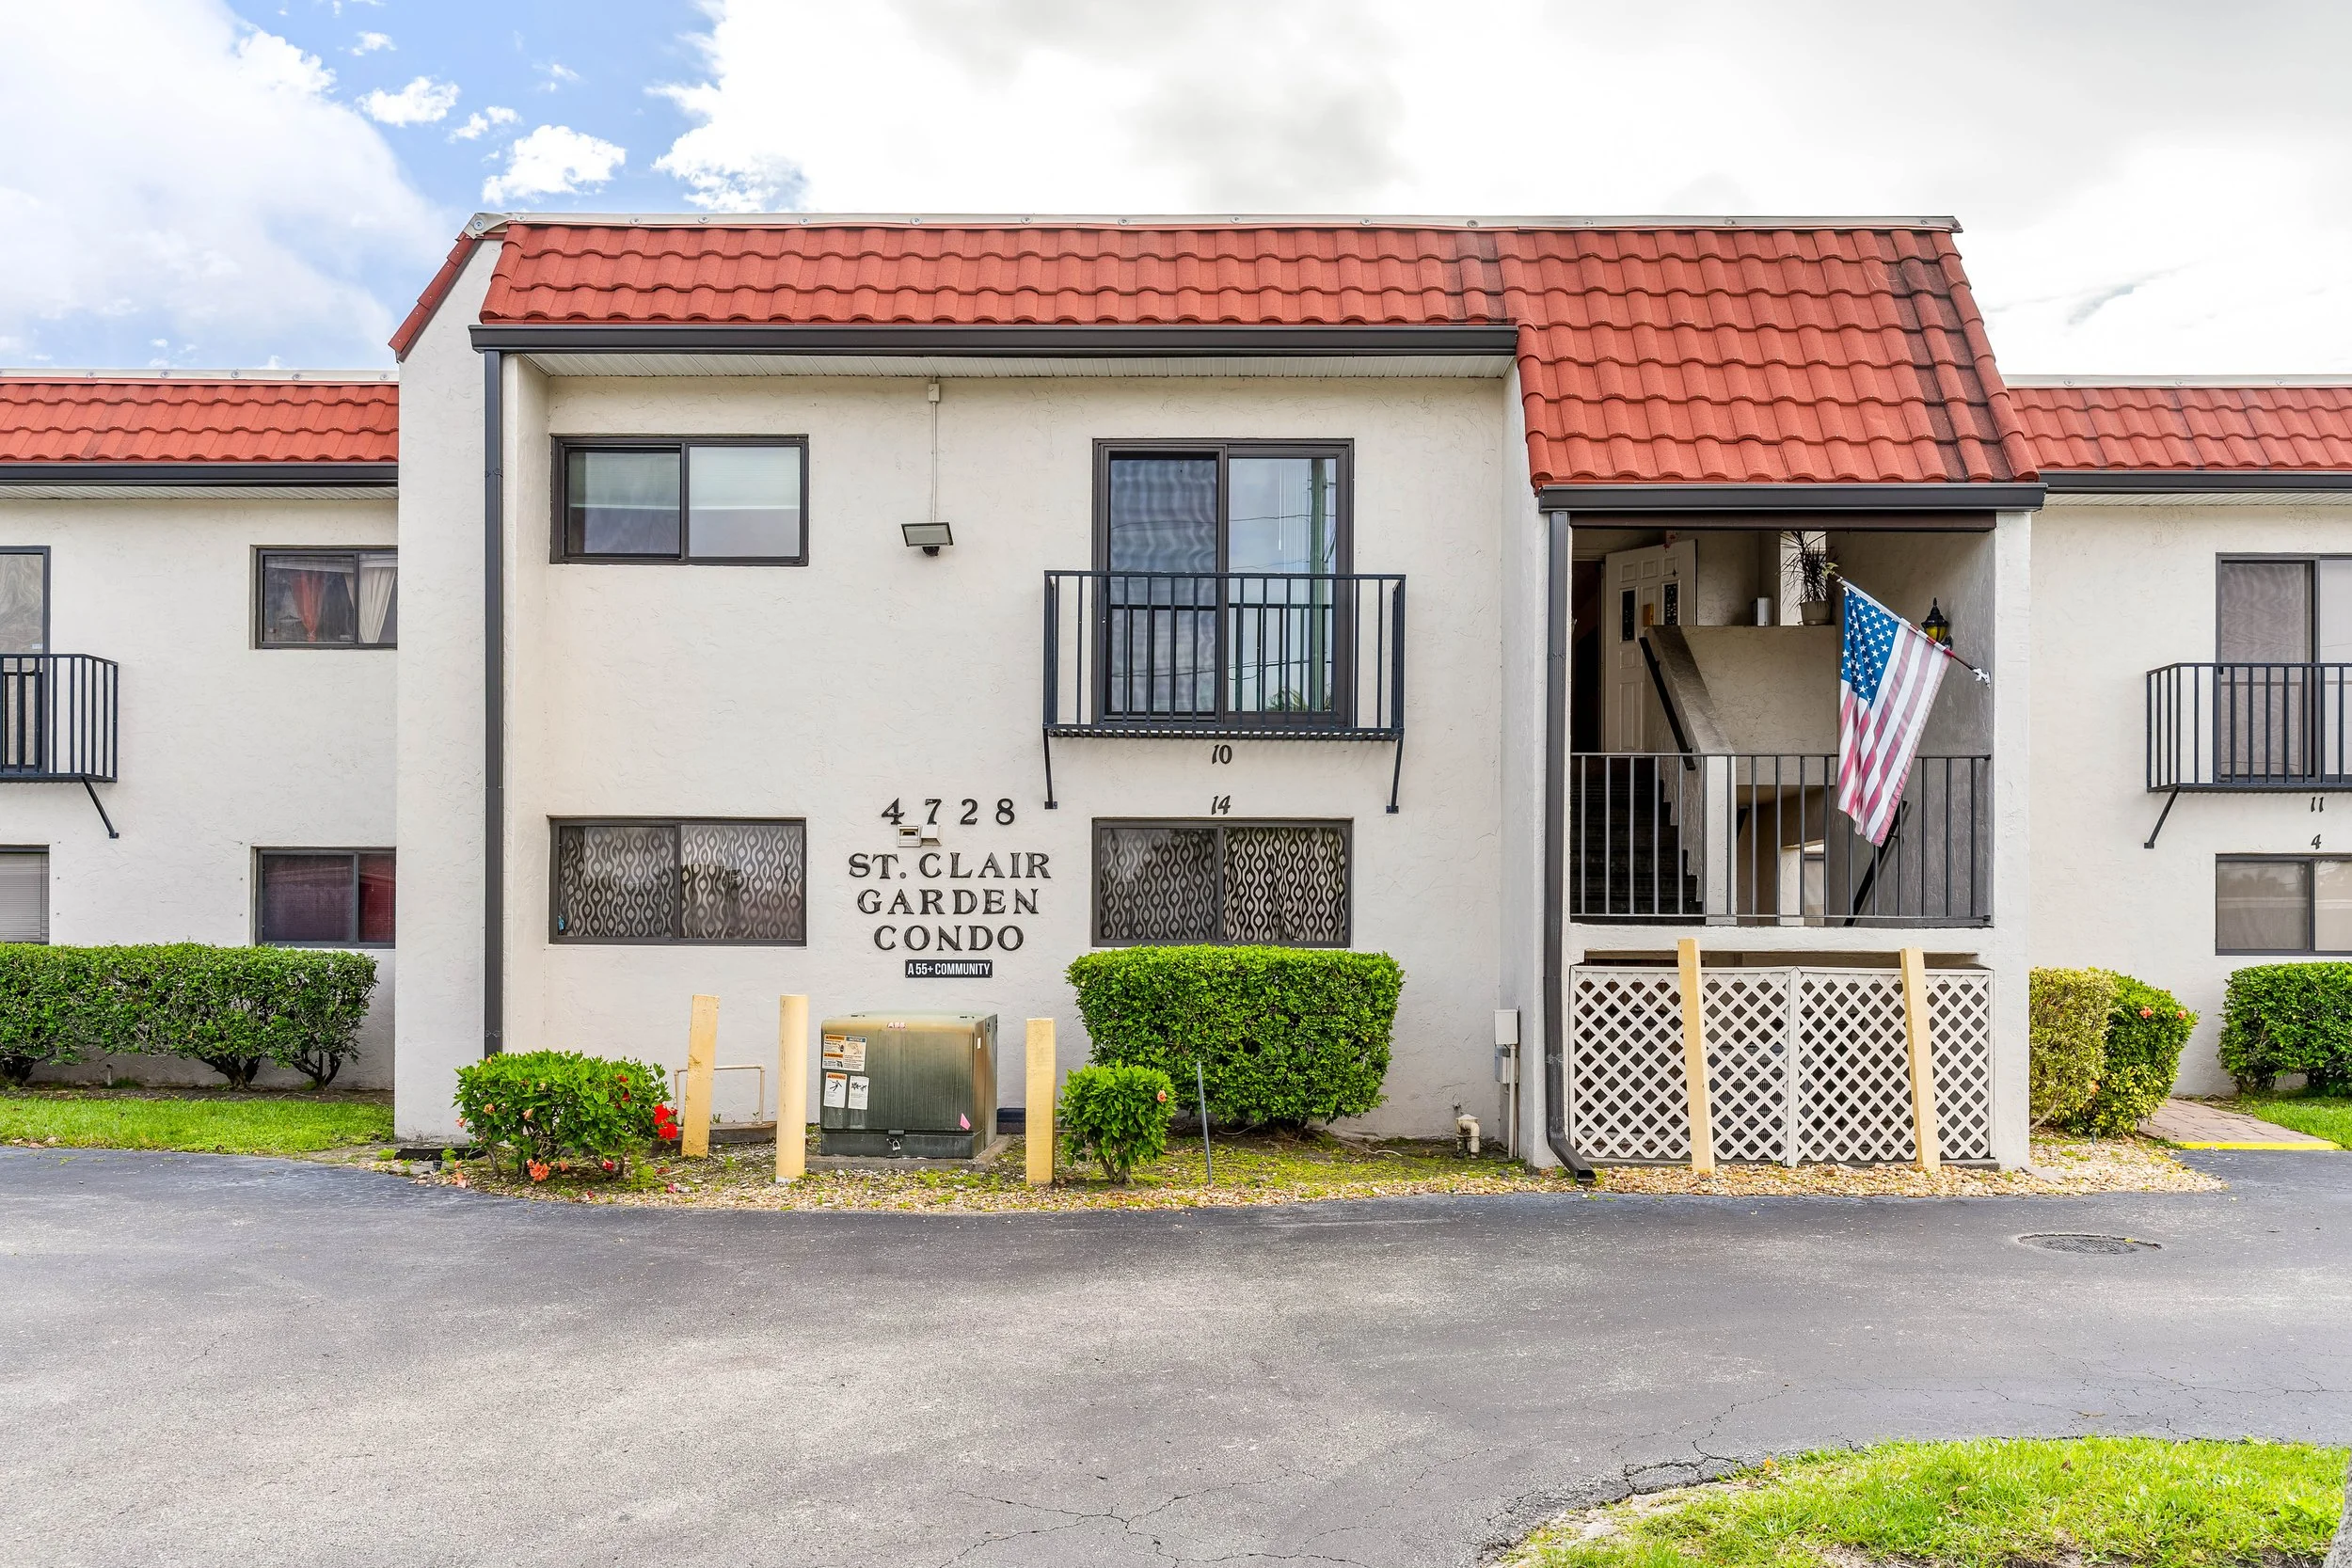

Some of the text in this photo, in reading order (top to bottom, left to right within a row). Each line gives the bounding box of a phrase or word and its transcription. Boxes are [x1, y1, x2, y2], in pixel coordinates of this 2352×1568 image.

[1211, 744, 1232, 765] 10
[881, 798, 1015, 825] 4728
[1211, 795, 1232, 816] 14
[2310, 796, 2325, 813] 11
[2311, 833, 2322, 849] 4
[849, 852, 1052, 879] ST. CLAIR
[857, 888, 1040, 915] GARDEN
[873, 925, 1025, 952] CONDO
[907, 962, 991, 975] A 55+ COMMUNITY
